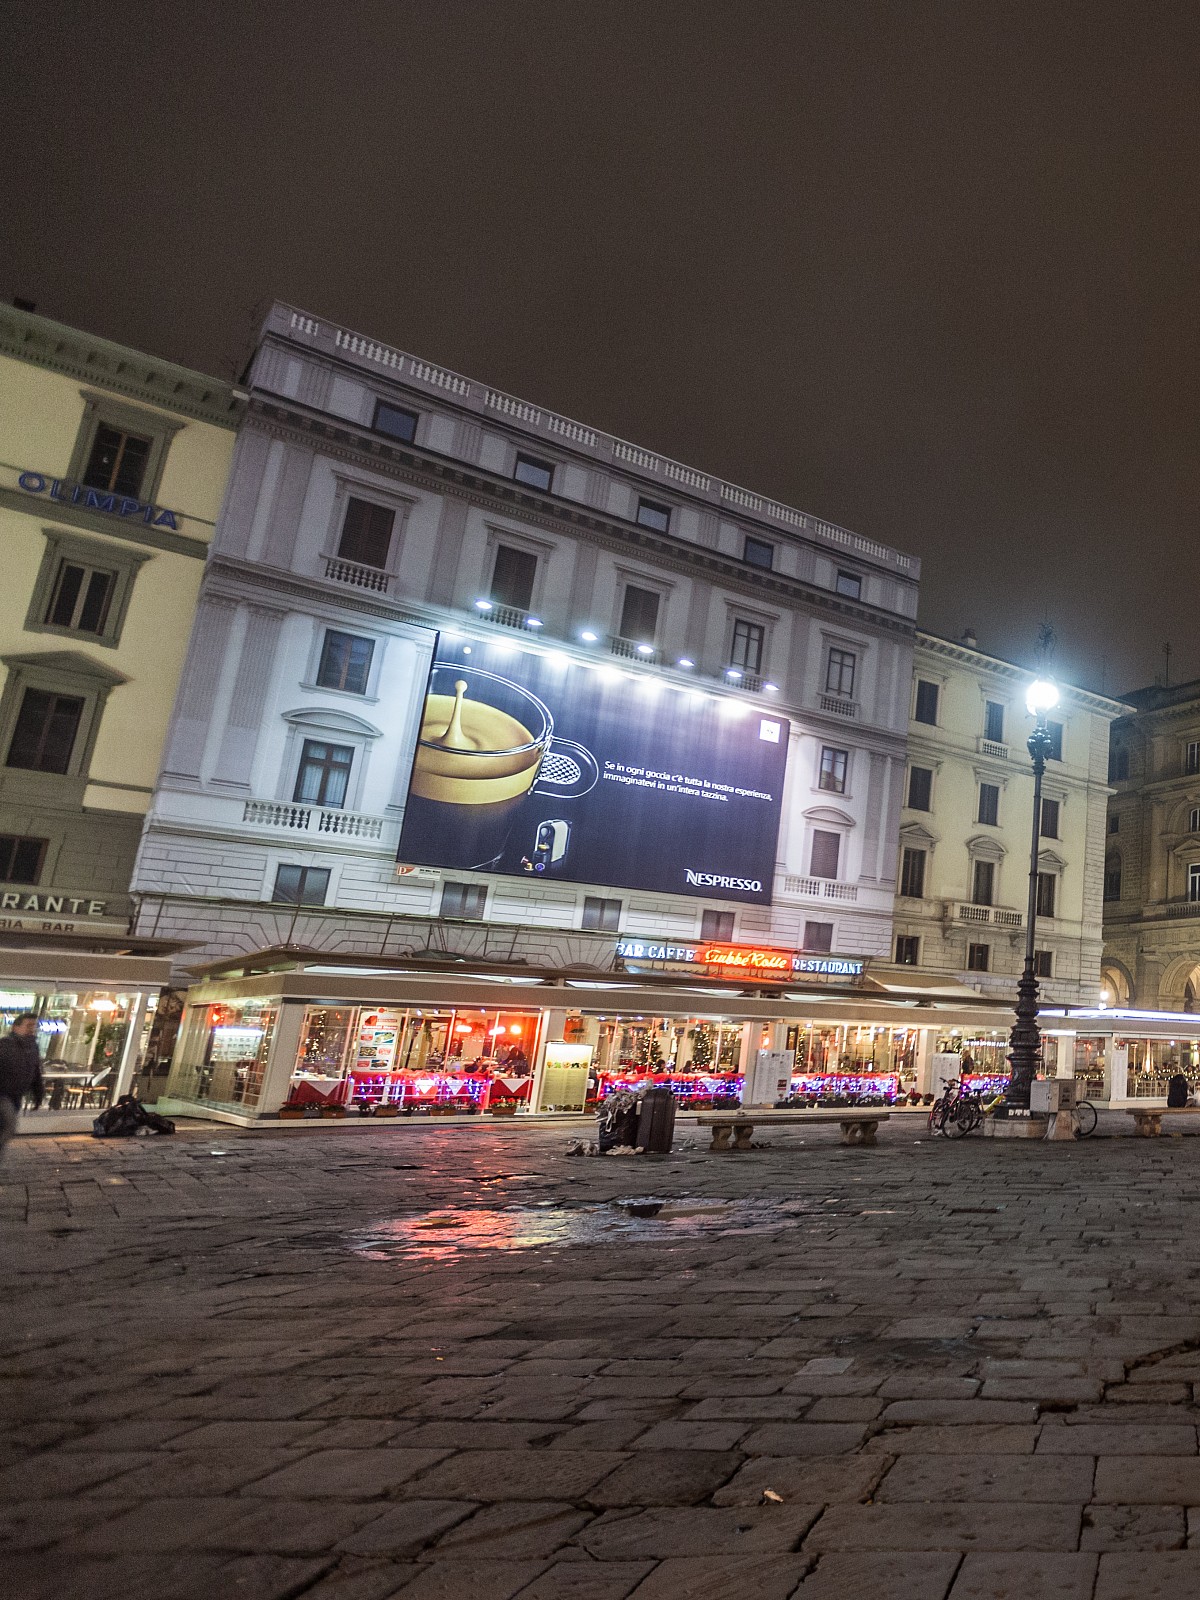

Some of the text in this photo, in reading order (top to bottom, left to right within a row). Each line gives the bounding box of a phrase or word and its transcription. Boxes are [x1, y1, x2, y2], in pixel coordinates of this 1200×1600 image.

[18, 471, 178, 530] OLIMPIA
[603, 771, 657, 788] immaginatevi
[657, 781, 665, 790] in
[604, 761, 616, 770] Se
[616, 763, 625, 771] in
[626, 767, 645, 775] ogni
[645, 771, 671, 780] goccia
[684, 777, 703, 786] tutta
[703, 780, 711, 788] la
[711, 783, 735, 793] nostra
[1, 892, 106, 916] RANTE
[42, 921, 75, 932] BAR
[615, 942, 645, 957] BAR
[792, 958, 863, 974] RESTAURANT
